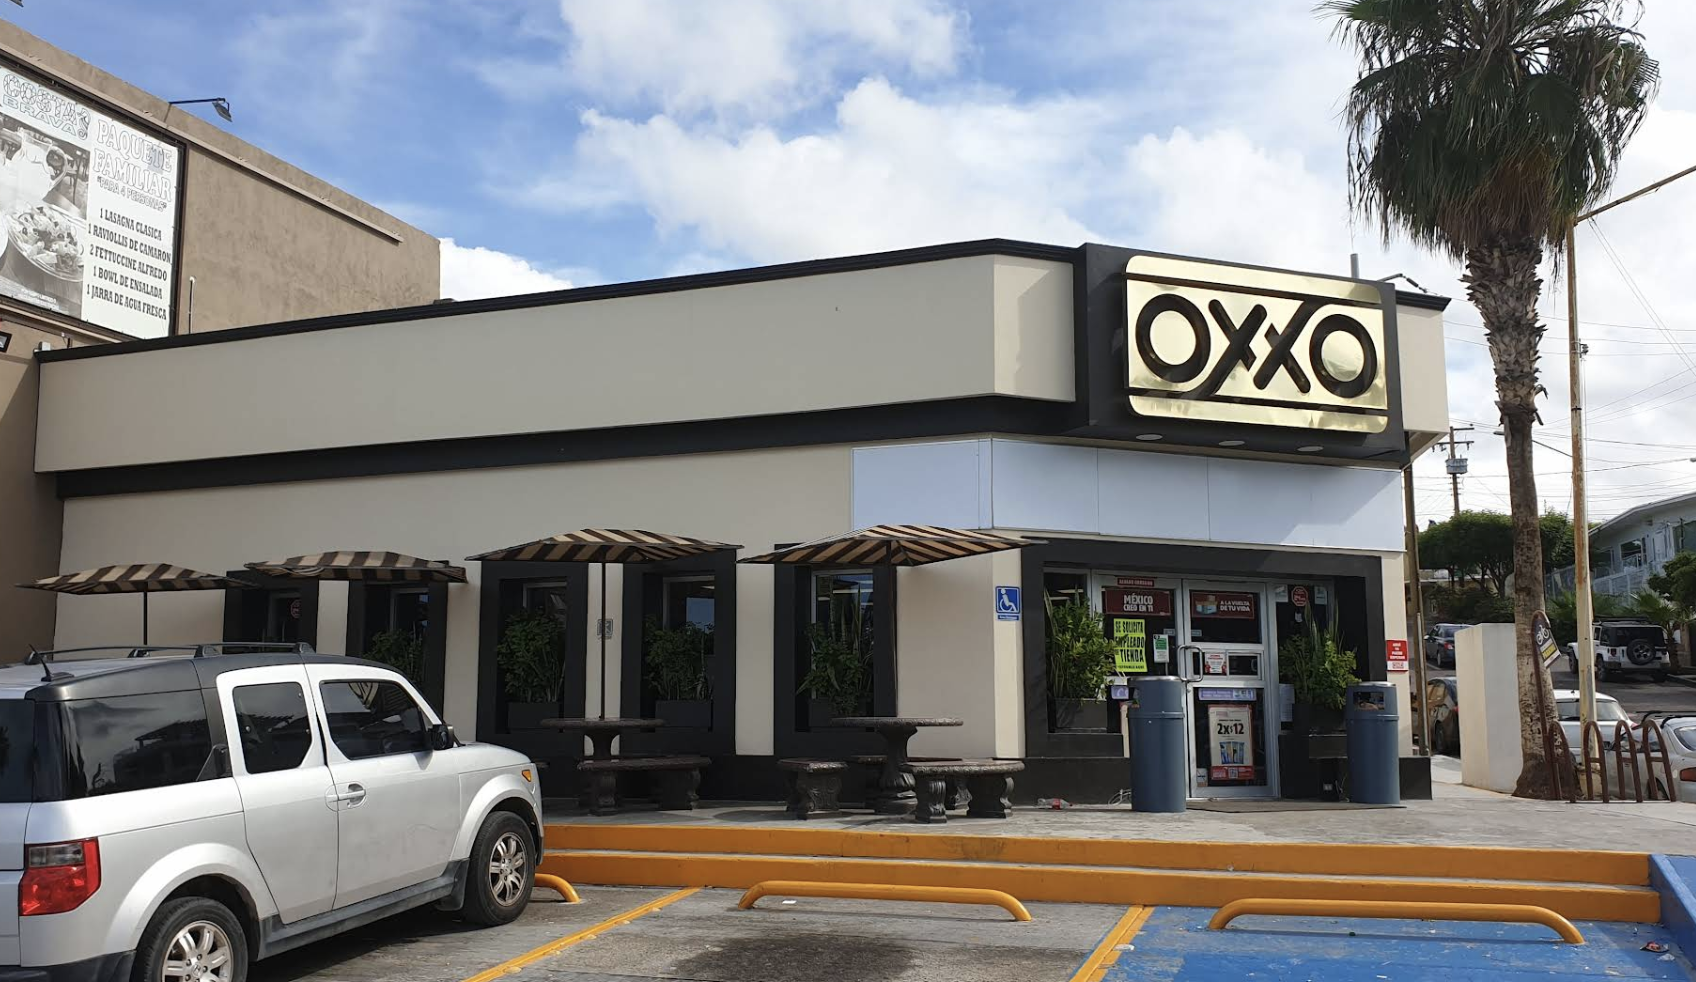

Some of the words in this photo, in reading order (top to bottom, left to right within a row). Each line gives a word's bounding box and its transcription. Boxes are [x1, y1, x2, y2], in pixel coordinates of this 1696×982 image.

[97, 119, 172, 173] PAQUETE
[93, 148, 172, 202] FAMILIAR
[100, 208, 103, 219] 1
[105, 209, 134, 231] LASAGNA
[135, 222, 162, 241] CLASICA
[88, 223, 91, 234] 1
[129, 238, 138, 252] DE
[139, 242, 171, 264] CAMARON
[89, 244, 94, 255] 2
[95, 246, 137, 271] FETTUCCINE
[137, 261, 168, 282] ALFREDO
[93, 265, 97, 277] 1
[98, 267, 119, 284] BOWL
[119, 274, 129, 288] DE
[130, 278, 163, 300] ENSALADA
[87, 284, 90, 295] 1
[91, 285, 113, 303] JARRA
[114, 293, 123, 306] DE
[124, 296, 141, 312] AGUA
[142, 302, 167, 320] FRESCA
[1135, 293, 1377, 398] OXXO
[1123, 592, 1154, 605] MÉXICO
[1123, 604, 1137, 612] CREO
[1115, 621, 1121, 633] SE
[1122, 621, 1144, 633] SOLICITA
[1119, 649, 1144, 662] TIENDA
